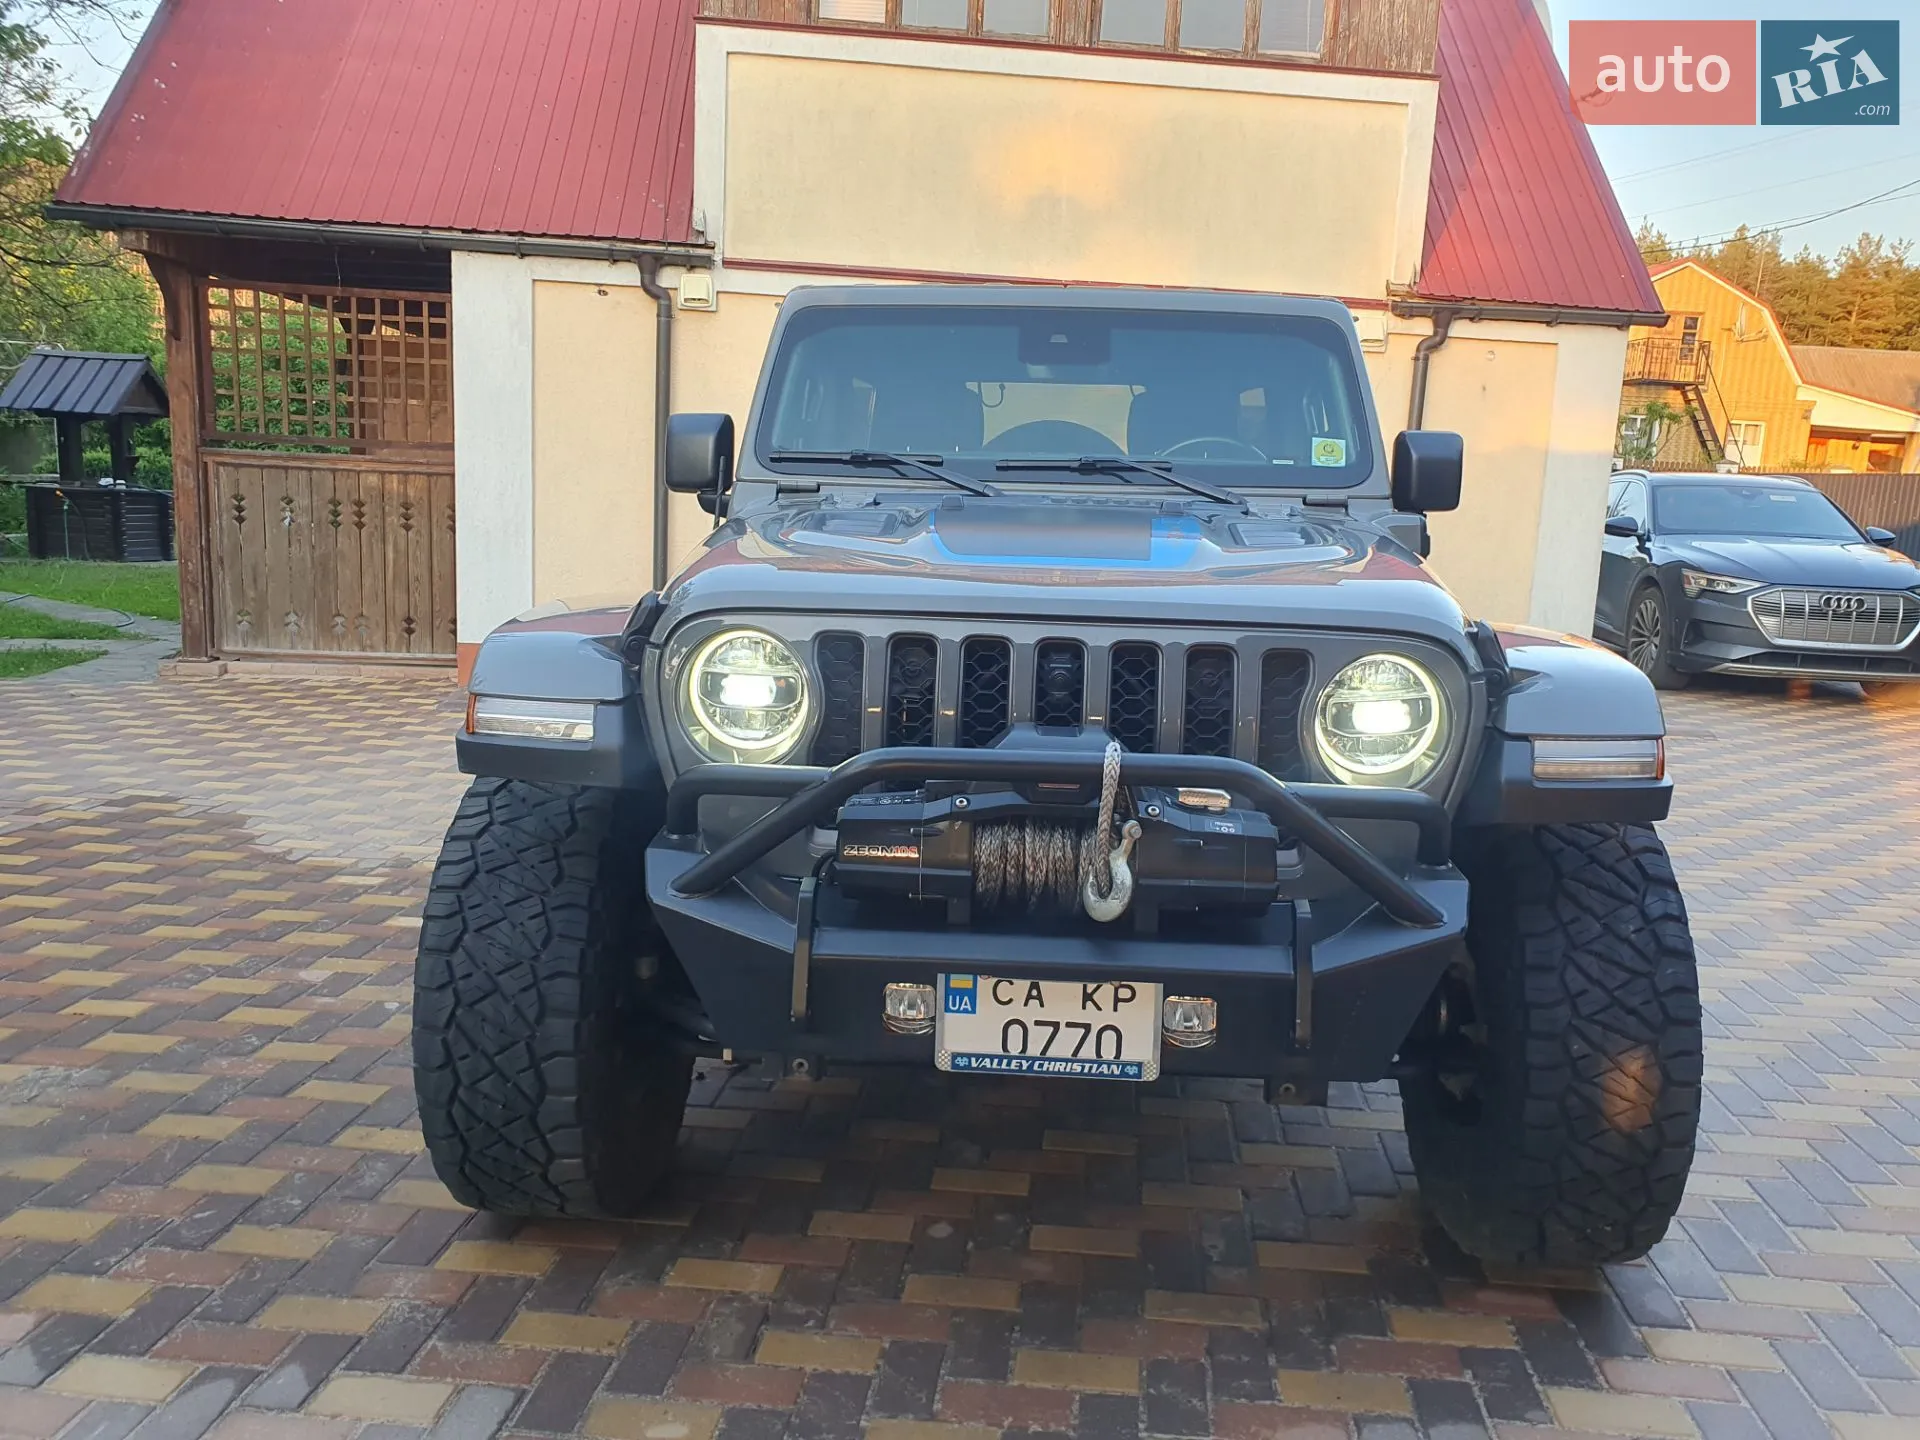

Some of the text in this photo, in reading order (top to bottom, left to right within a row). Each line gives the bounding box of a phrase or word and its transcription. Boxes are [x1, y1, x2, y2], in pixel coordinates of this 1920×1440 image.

[949, 995, 972, 1012] UA
[991, 979, 1137, 1012] CA KP
[1001, 1018, 1123, 1060] 0770
[970, 1056, 1123, 1076] VALLEY CHRISTIAN
